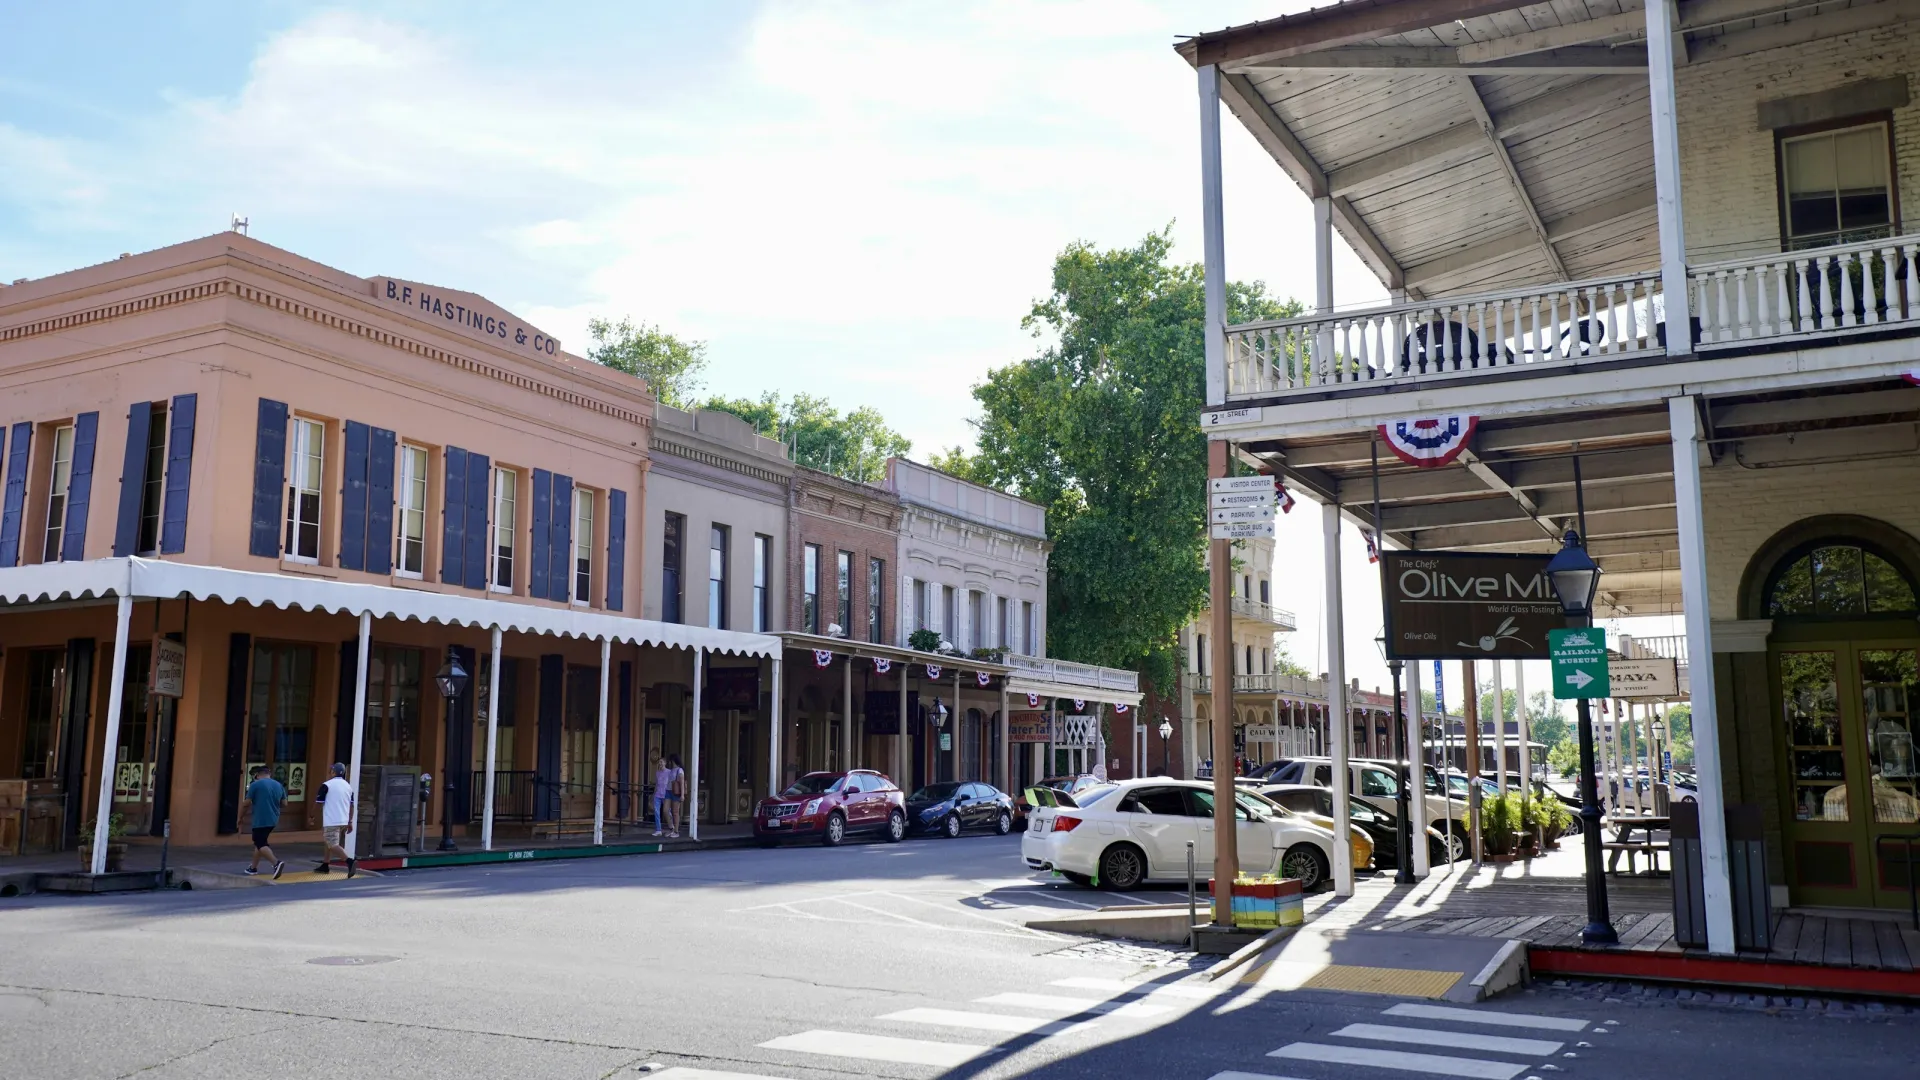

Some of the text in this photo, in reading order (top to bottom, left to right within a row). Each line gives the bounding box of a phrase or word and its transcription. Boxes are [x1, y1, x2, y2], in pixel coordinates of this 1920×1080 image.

[386, 280, 557, 357] B.F. HASTINGS & CO.
[1227, 409, 1249, 418] STREET
[1251, 479, 1270, 487] CENTER
[1399, 559, 1413, 568] The
[1399, 569, 1558, 598] Olive Mi
[1488, 605, 1509, 613] World
[1511, 605, 1529, 613] Class
[1531, 606, 1555, 615] Tasting
[1404, 632, 1437, 640] Olive Oils
[1553, 648, 1604, 656] RAILROAD
